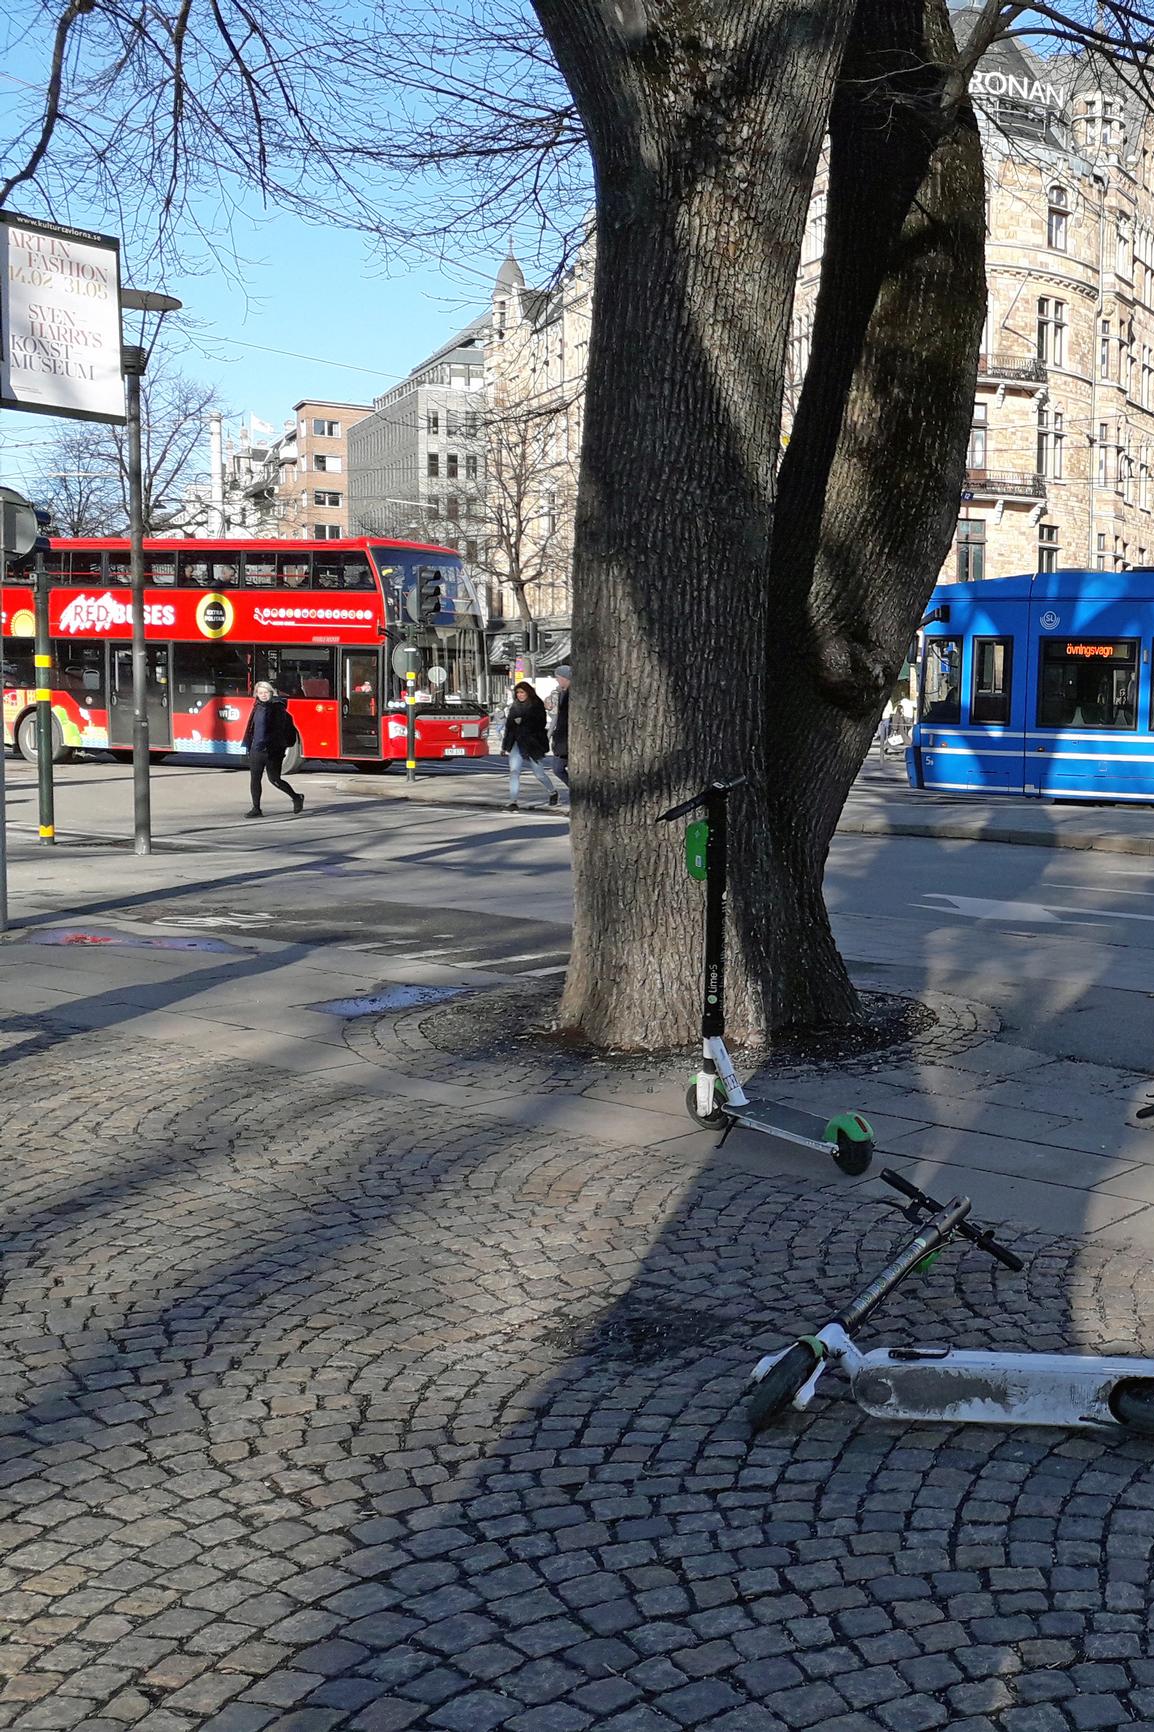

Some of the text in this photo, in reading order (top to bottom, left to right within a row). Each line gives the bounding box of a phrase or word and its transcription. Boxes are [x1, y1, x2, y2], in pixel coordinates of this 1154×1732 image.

[9, 230, 71, 259] ART IN
[28, 252, 108, 283] FASHION
[64, 276, 108, 300] 31.05
[30, 321, 103, 348] HARRYS
[11, 352, 96, 381] MUSEUM
[73, 604, 109, 623] RED
[1045, 614, 1054, 622] SL
[1066, 643, 1113, 658] övningsvagn
